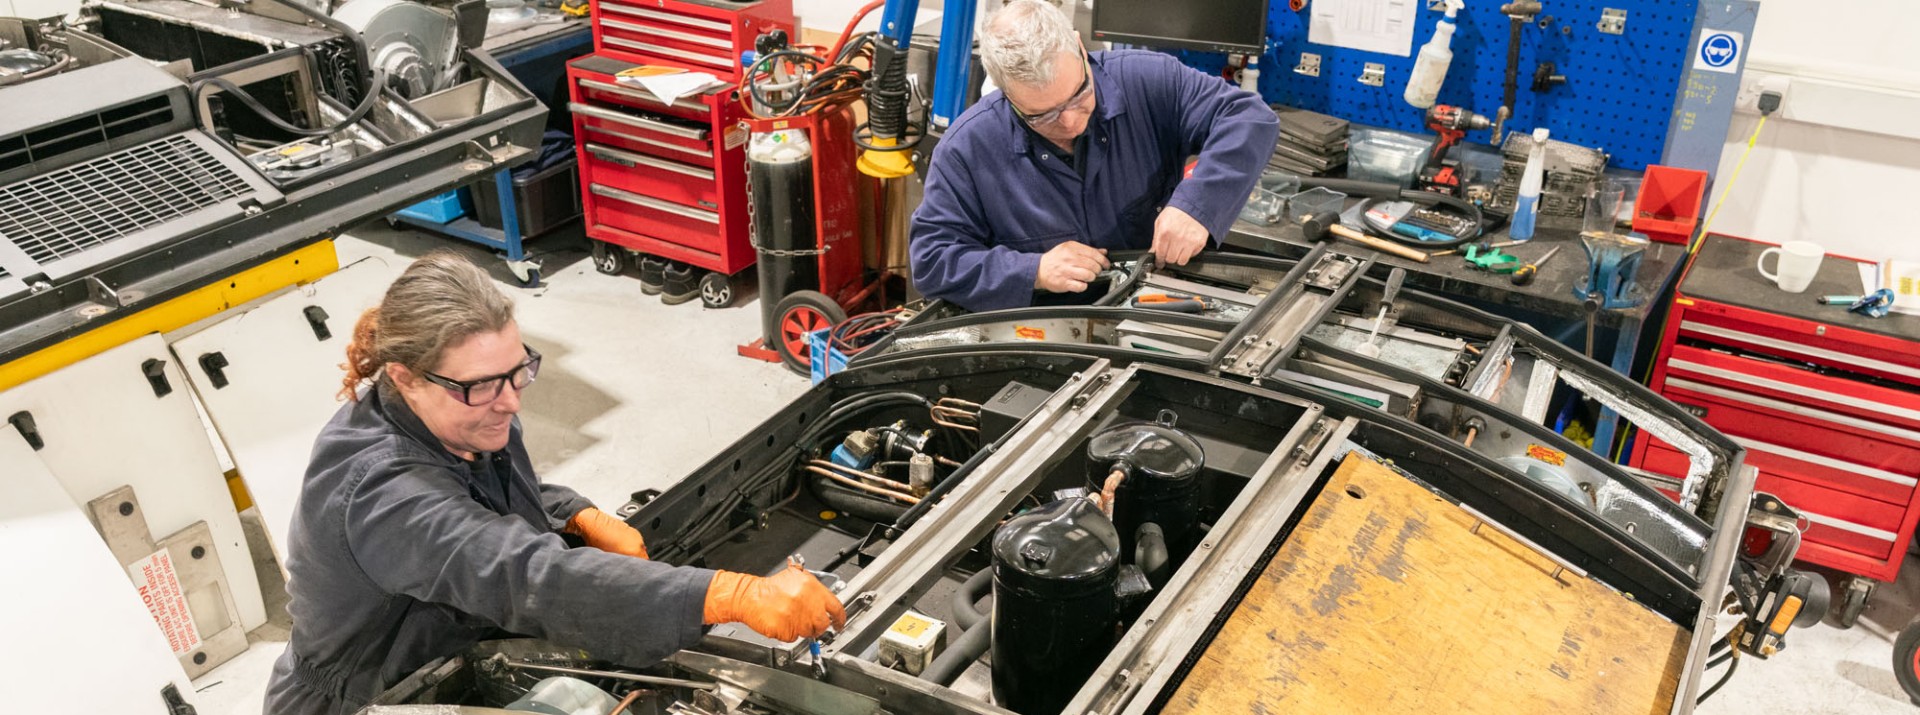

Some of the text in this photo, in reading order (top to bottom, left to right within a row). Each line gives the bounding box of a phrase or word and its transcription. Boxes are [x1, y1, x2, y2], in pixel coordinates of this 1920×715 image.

[156, 573, 166, 585] FOR
[161, 584, 171, 597] OFF
[160, 553, 198, 645] BEFORE OPENING ACCESS PANEL
[165, 596, 173, 604] IS
[143, 564, 181, 652] ROTATING PARTS INSIDE
[168, 604, 179, 618] UNIT
[178, 629, 191, 653] ENSURE
